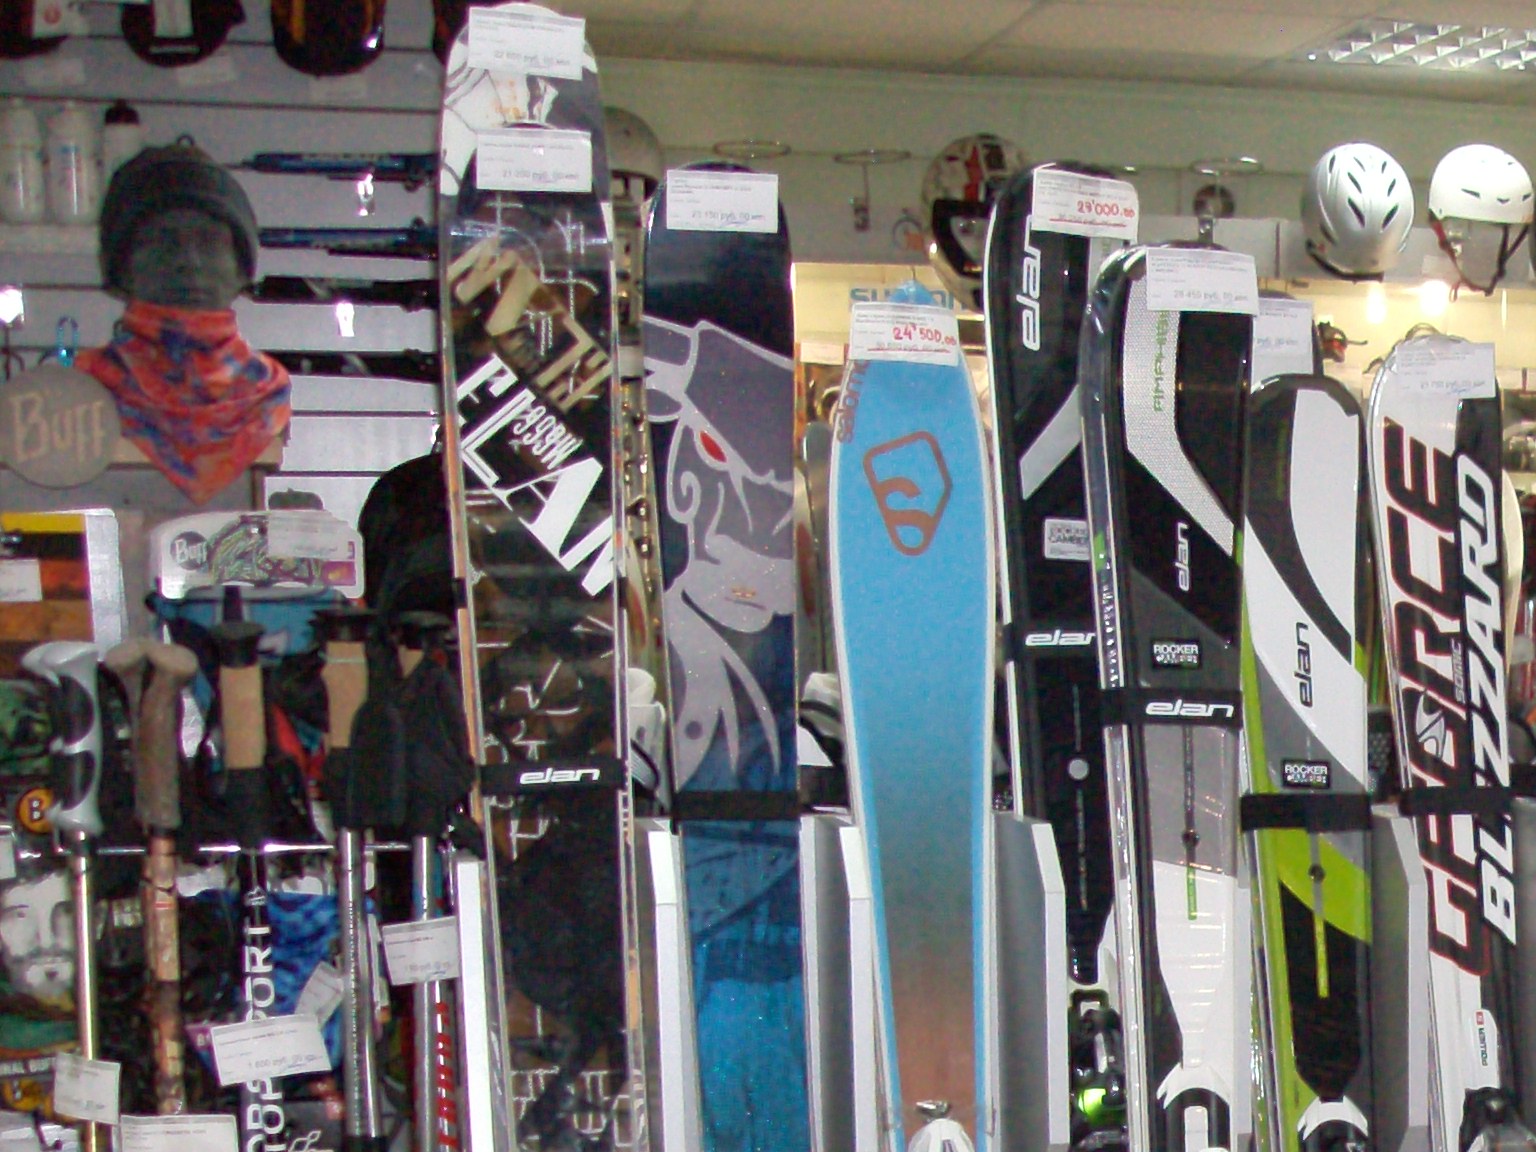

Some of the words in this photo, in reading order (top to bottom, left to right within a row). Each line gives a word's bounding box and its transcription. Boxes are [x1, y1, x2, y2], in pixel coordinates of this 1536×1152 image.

[1174, 521, 1190, 592] elan
[1153, 644, 1199, 655] ROCKER
[1294, 621, 1313, 708] elan
[1146, 699, 1235, 718] elan
[1455, 454, 1517, 946] BLZZARD
[520, 766, 600, 785] elan
[1284, 764, 1328, 775] ROCKER
